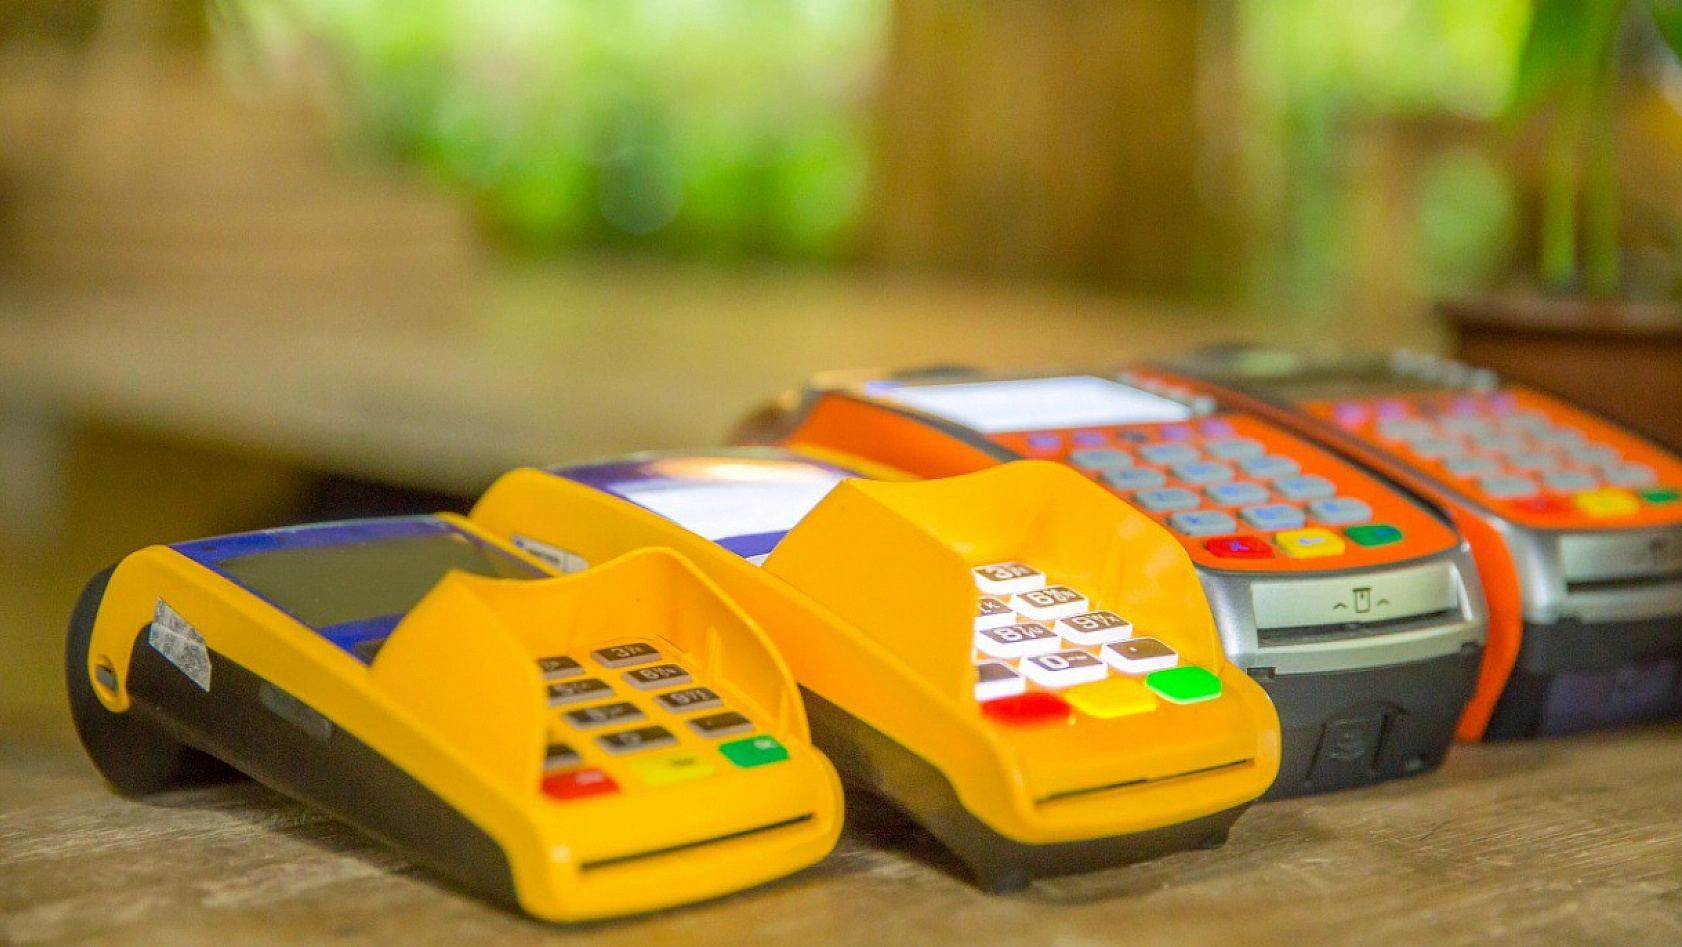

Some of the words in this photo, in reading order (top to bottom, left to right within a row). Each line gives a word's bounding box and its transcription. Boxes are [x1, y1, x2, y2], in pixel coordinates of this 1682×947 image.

[1071, 617, 1099, 629] 9
[993, 626, 1023, 641] 8
[1039, 655, 1070, 669] 0
